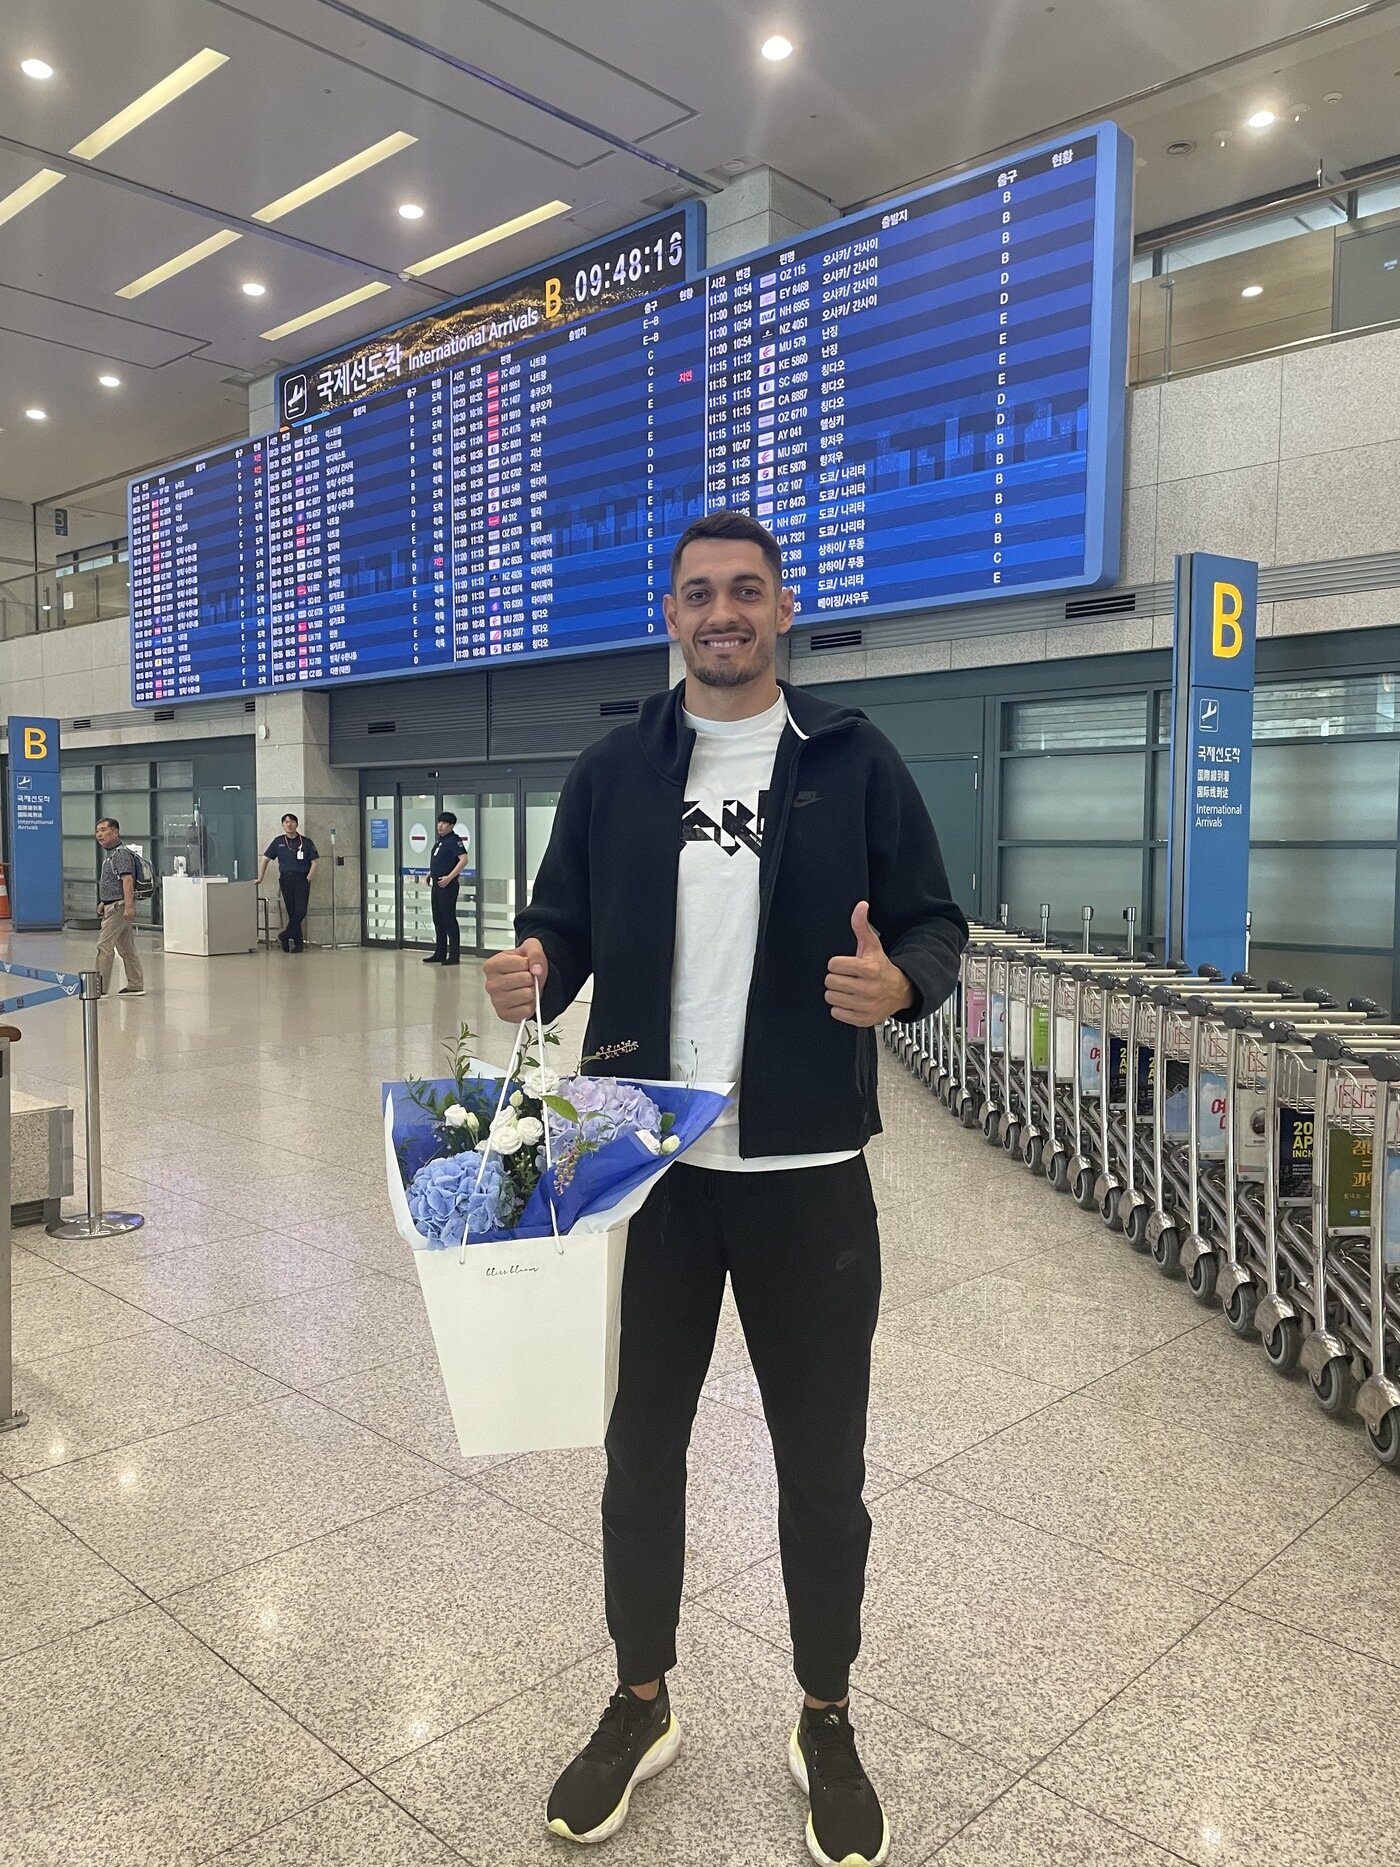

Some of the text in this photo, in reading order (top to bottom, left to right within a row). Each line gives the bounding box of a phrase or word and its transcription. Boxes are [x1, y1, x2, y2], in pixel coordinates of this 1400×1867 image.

[710, 291, 727, 306] 11:00
[734, 282, 752, 297] 10:54
[780, 269, 791, 281] OZ
[793, 264, 806, 276] 115
[853, 237, 878, 256] 간사이
[1003, 191, 1010, 203] B
[710, 308, 727, 323] 11:00
[733, 300, 752, 315] 10:54
[780, 287, 790, 299] EY
[853, 256, 877, 275] 간사이
[1002, 212, 1010, 223] B
[709, 326, 727, 340] 11:00
[733, 318, 751, 332] 10:54
[780, 304, 791, 317] NH
[793, 299, 809, 312] 6955
[852, 275, 877, 293] 간사이
[1002, 232, 1009, 244] B
[709, 343, 727, 357] 11:00
[733, 335, 751, 349] 10:54
[779, 323, 790, 334] NZ
[852, 294, 876, 312] 간사이
[1002, 252, 1008, 264] B
[711, 276, 726, 288] 시간
[317, 343, 402, 401] 국제선도착
[408, 327, 485, 370] International
[488, 307, 538, 341] Arrivals
[545, 278, 561, 318] B
[709, 273, 1008, 374] 11:15 11:12 MU 579 난징 D
[709, 377, 726, 391] 11:15
[732, 370, 751, 384] 11:12
[778, 358, 790, 370] KE
[822, 343, 837, 358] 난징
[1000, 293, 1008, 304] D
[648, 350, 654, 360] C
[708, 411, 726, 424] 11:15
[732, 404, 750, 418] 11:15
[778, 394, 790, 405] CA
[820, 378, 844, 394] 칭다오
[999, 333, 1006, 344] E
[709, 313, 1007, 408] 11:15 11:15 SC 4609 칭다오 E
[708, 353, 1006, 441] 11:15 11:15 OZ 6710 칭다오 E
[708, 445, 726, 458] 11:20
[732, 439, 750, 452] 10:47
[778, 429, 788, 440] AY
[998, 373, 1005, 385] E
[708, 393, 1005, 475] 11:25 11:25 MU 5071 항저우 D
[708, 479, 726, 492] 11:25
[732, 473, 750, 486] 11:25
[777, 464, 788, 475] KE
[820, 451, 843, 466] 항저우
[996, 414, 1004, 425] D
[708, 433, 1004, 508] 11:30 11:25 OZ 107 도쿄/ 나리타 B
[777, 500, 788, 510] EY
[789, 496, 805, 508] 8473
[818, 488, 839, 501] 도쿄/
[841, 482, 865, 497] 나리타
[996, 453, 1003, 464] B
[776, 473, 1002, 528] NH 6977 도쿄/ 나리타 B
[776, 493, 1002, 546] UA 7321 도쿄/ 나리타 B
[781, 552, 788, 562] Z
[818, 540, 846, 556] 상하이/
[994, 513, 1002, 524] B
[781, 569, 788, 579] O
[790, 566, 806, 578] 3110
[818, 558, 846, 574] 상하이/
[994, 533, 1001, 544] B
[818, 552, 1001, 590] 도쿄/ 나리타 C
[993, 572, 1000, 583] E
[1212, 582, 1242, 658] B
[24, 727, 48, 759] B
[1198, 746, 1240, 763] 국제선도착
[1195, 816, 1222, 828] Arrivals
[1196, 804, 1242, 814] International
[1292, 1150, 1313, 1158] INCH
[1293, 1121, 1313, 1135] 20
[1293, 1136, 1313, 1149] AP
